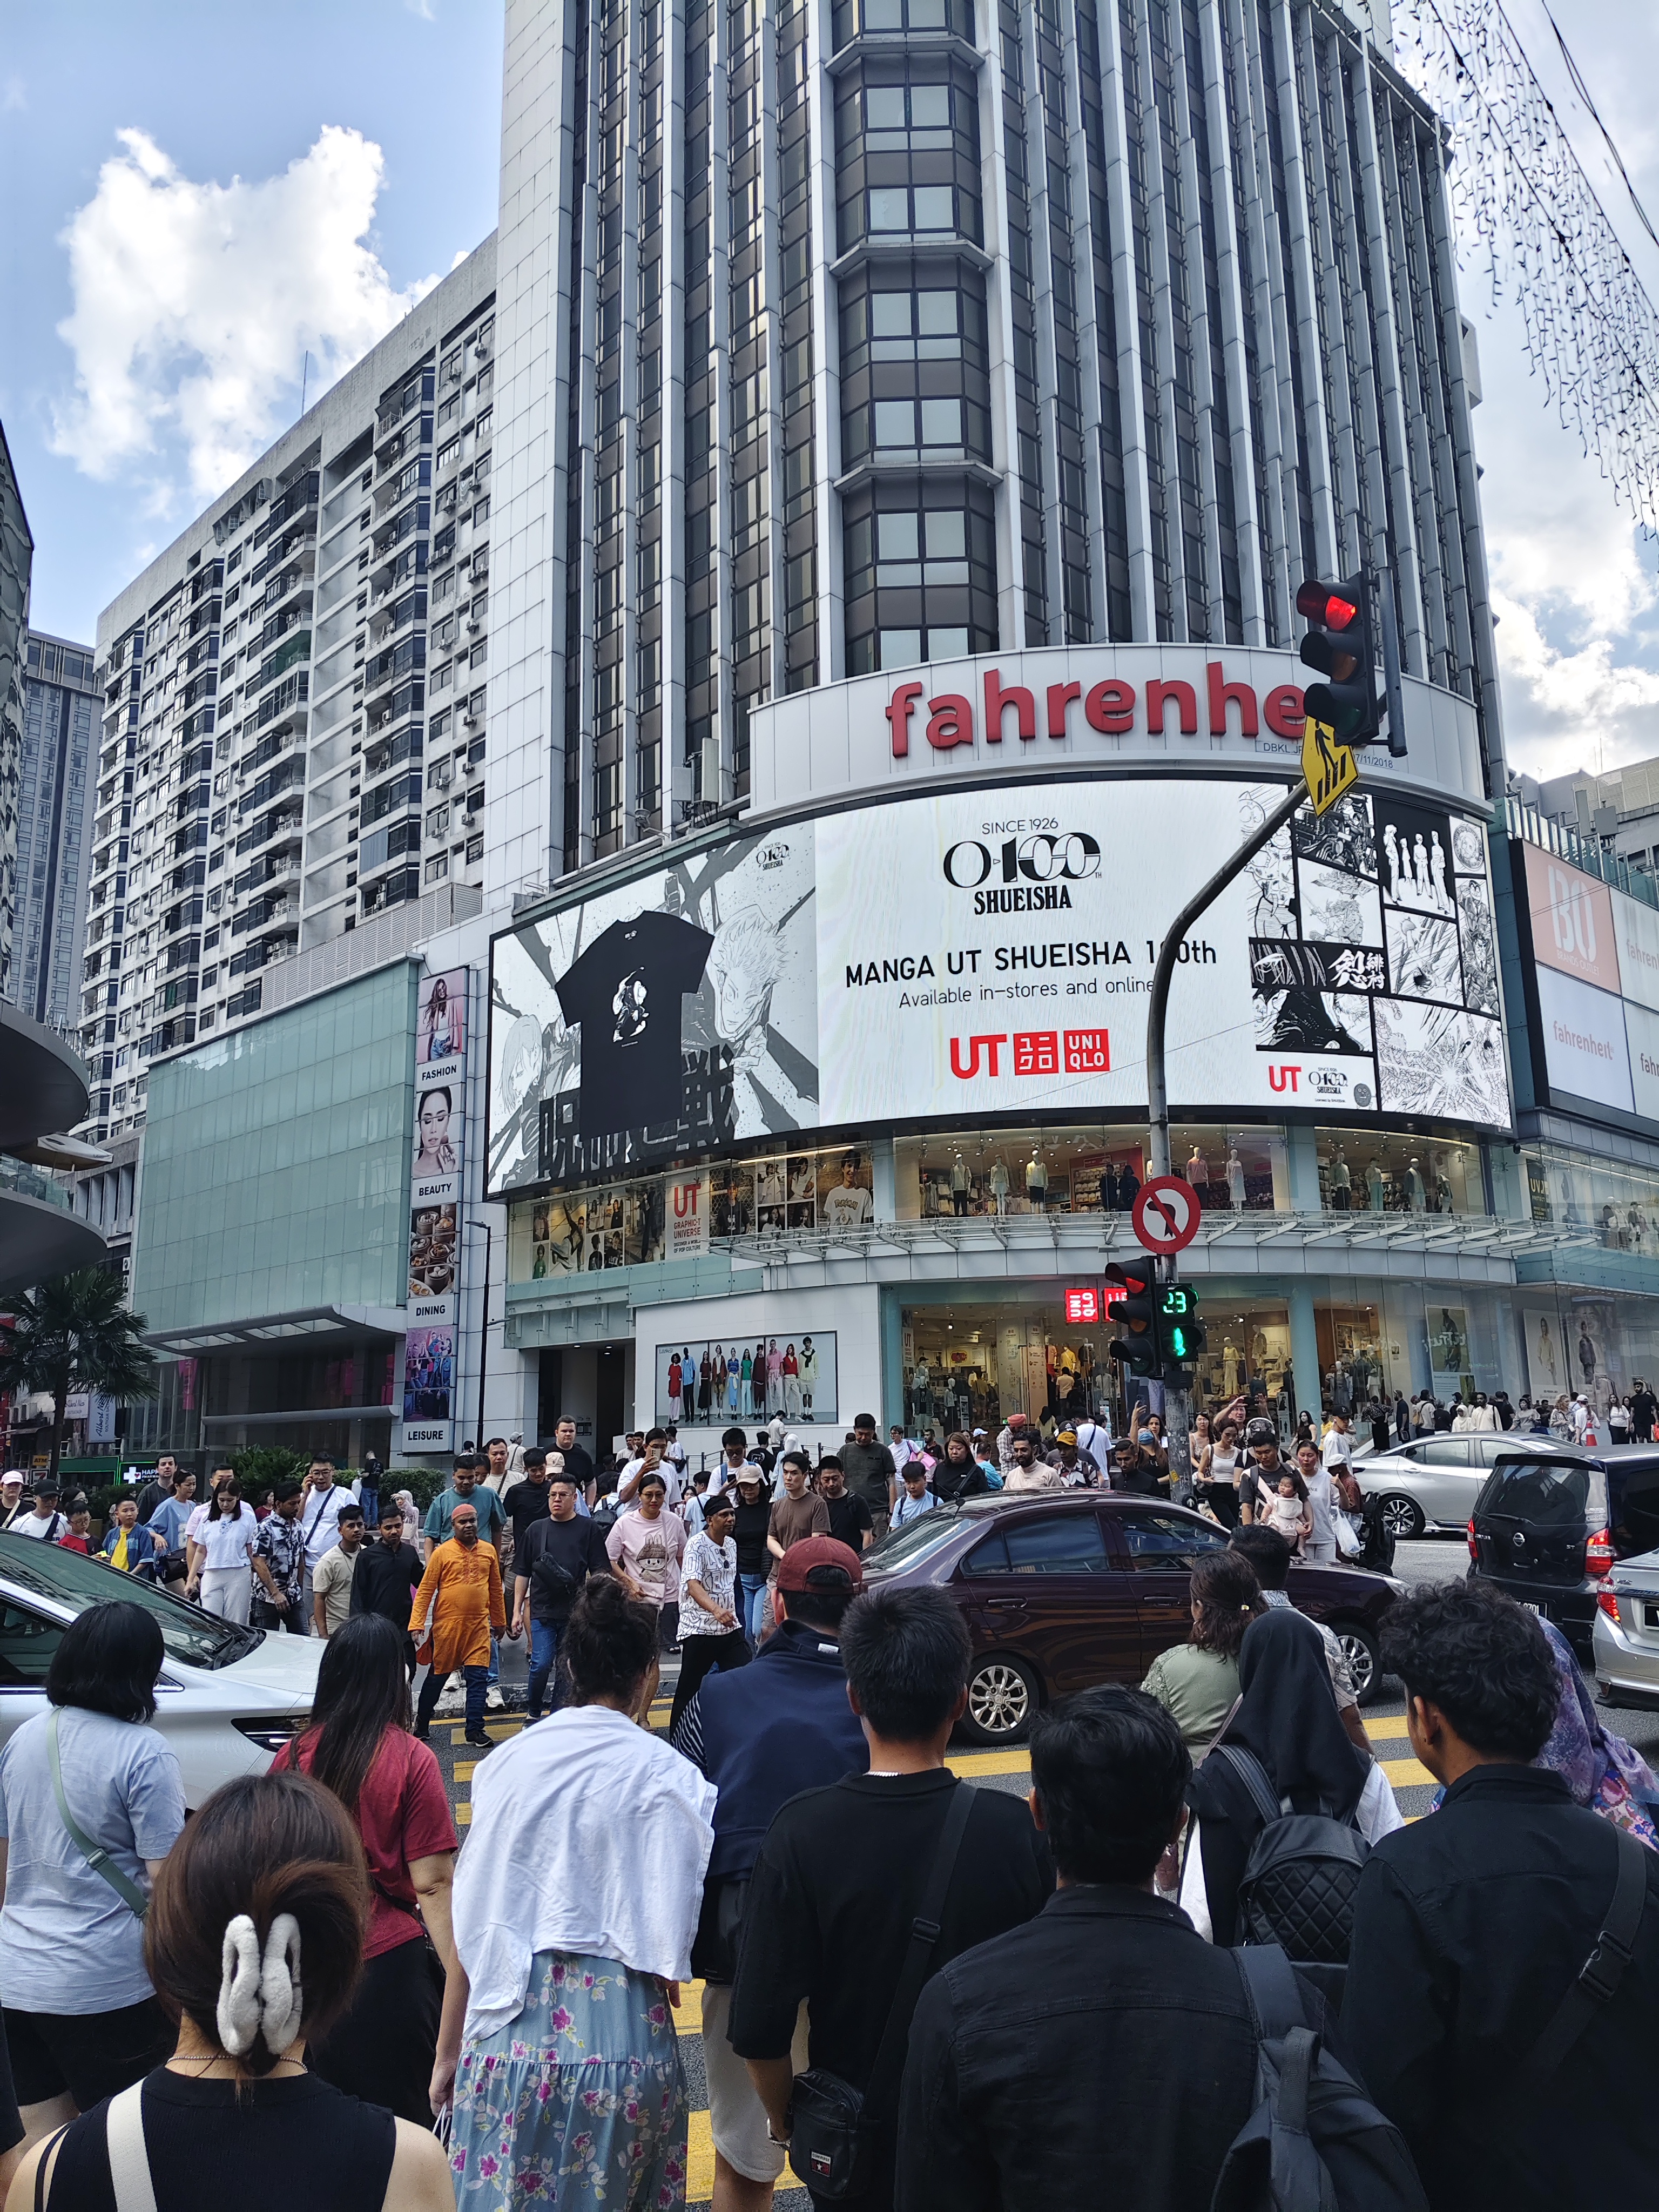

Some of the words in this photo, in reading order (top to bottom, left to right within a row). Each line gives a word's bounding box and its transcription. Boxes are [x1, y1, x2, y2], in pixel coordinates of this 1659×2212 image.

[886, 660, 1305, 758] fahrenhe
[982, 820, 1026, 835] SINCE
[1029, 818, 1058, 831] 1926
[974, 885, 1072, 915] SHUEISHA
[846, 955, 934, 988] MANGA
[947, 950, 982, 974] UT
[995, 941, 1131, 971] SHUEISHA
[1147, 940, 1216, 965] 10th
[1557, 949, 1579, 968] BRANDS
[1580, 960, 1599, 976] OUTLET
[899, 988, 972, 1008] Available
[980, 981, 1057, 1001] in-stores
[1066, 978, 1097, 996] and
[1106, 976, 1155, 994] online
[949, 1034, 1007, 1079] UT
[422, 1065, 457, 1081] FASHION
[1269, 1065, 1301, 1092] UT
[419, 1183, 451, 1196] BEAUTY
[674, 1183, 701, 1218] UT
[674, 1218, 701, 1229] GRAPHIC-T
[674, 1227, 701, 1239] UNIVERSE
[416, 1305, 446, 1316] DINING
[408, 1430, 443, 1441] LEISURE
